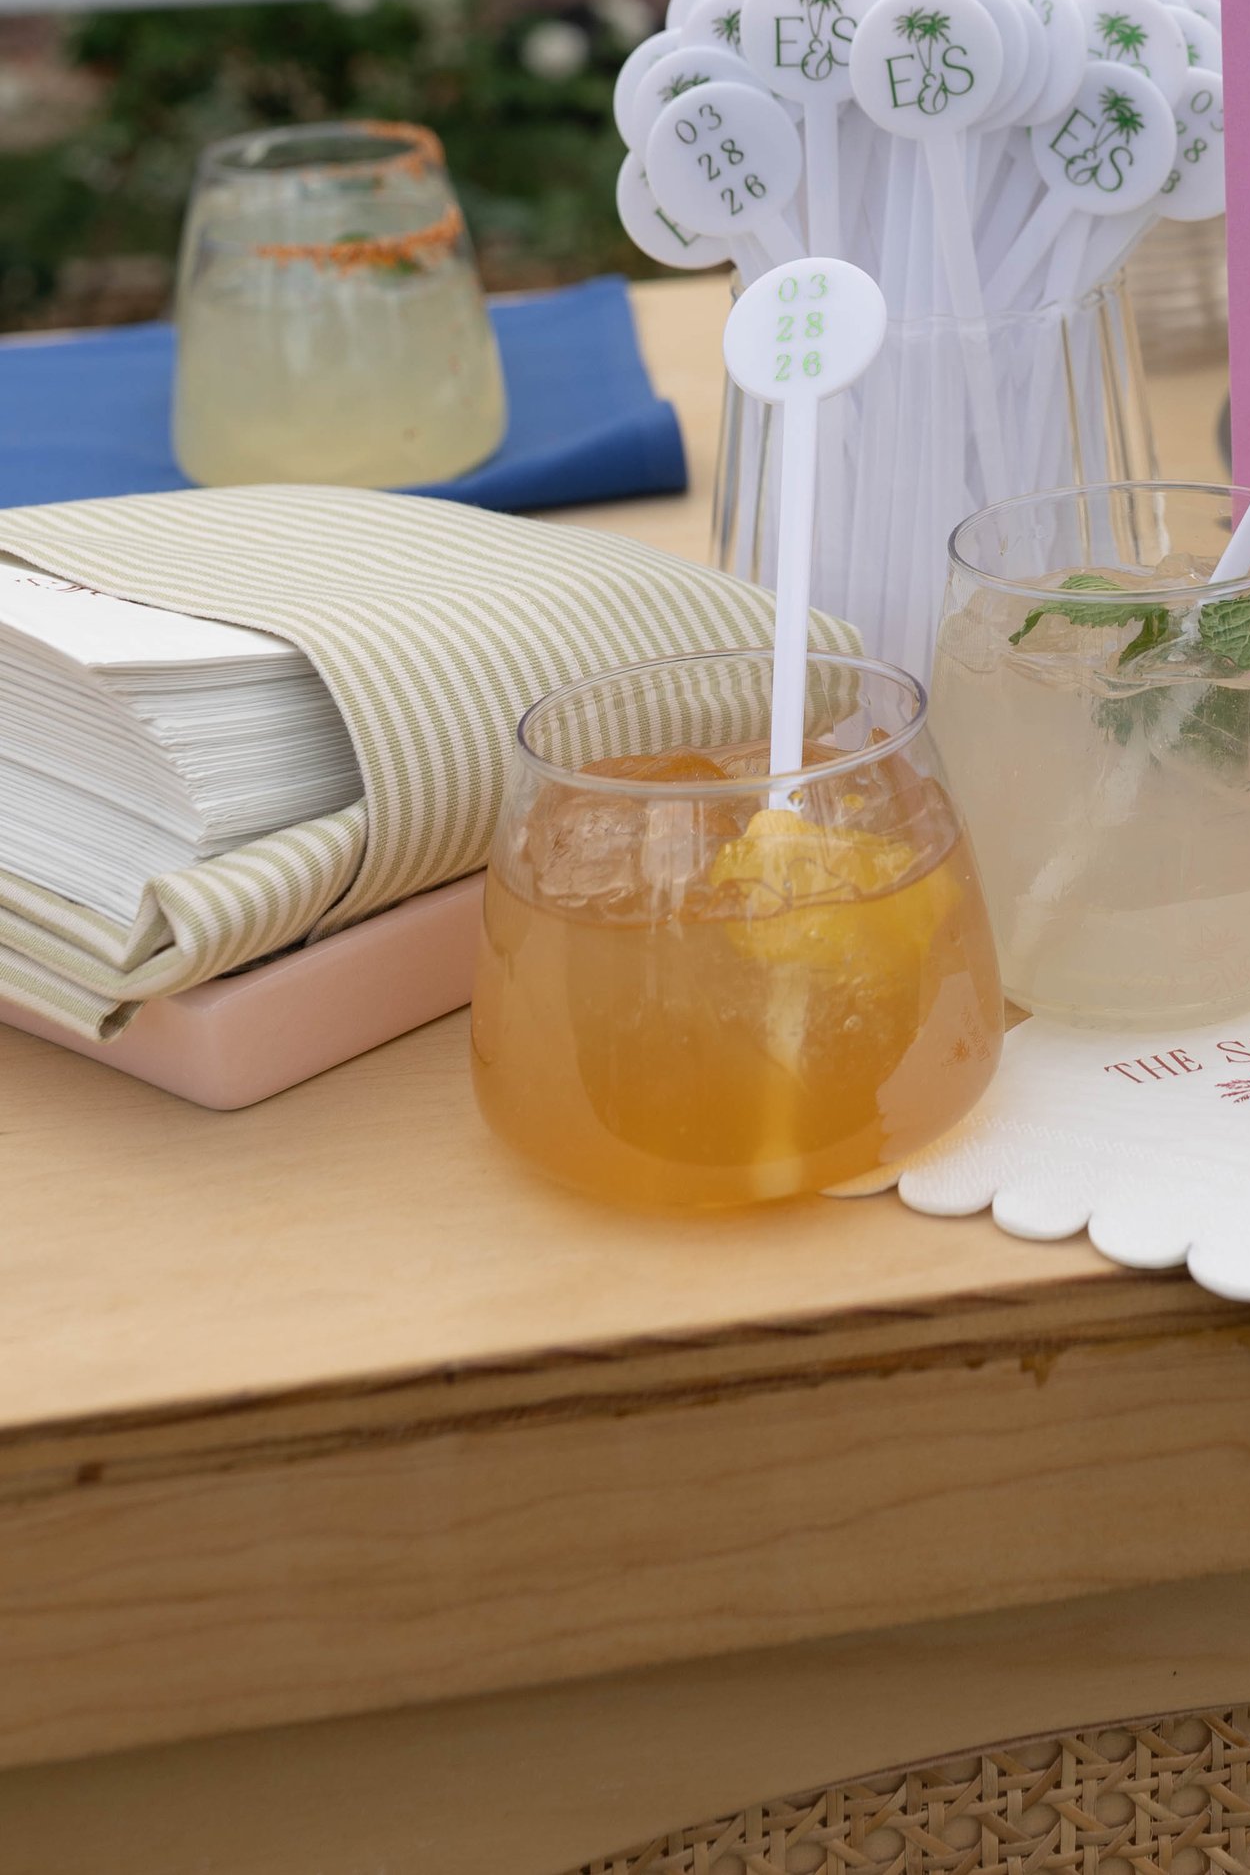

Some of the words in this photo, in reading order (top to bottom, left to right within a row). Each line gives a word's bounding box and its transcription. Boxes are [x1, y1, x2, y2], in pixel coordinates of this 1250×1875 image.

[885, 44, 975, 116] E&S
[674, 103, 723, 145] 03
[697, 138, 744, 181] 28
[1048, 107, 1134, 193] E&S
[720, 173, 767, 216] 26
[777, 272, 828, 303] 03
[775, 311, 825, 343] 28
[773, 350, 823, 382] 26
[1103, 1048, 1203, 1085] THE
